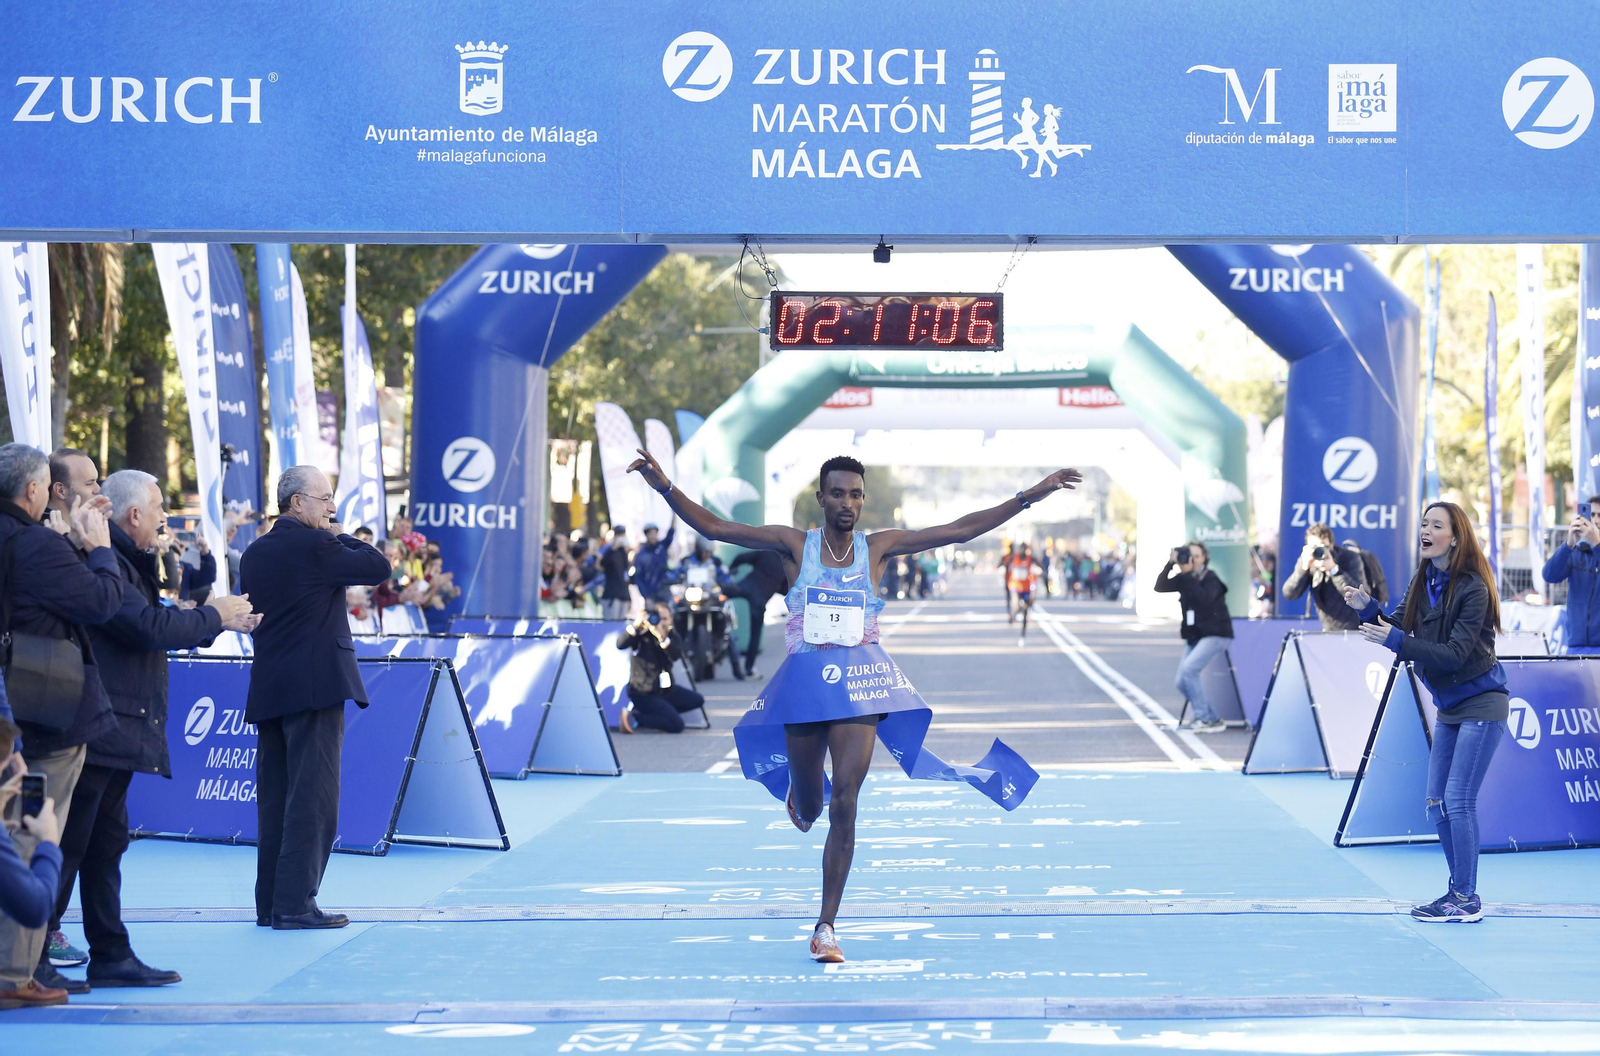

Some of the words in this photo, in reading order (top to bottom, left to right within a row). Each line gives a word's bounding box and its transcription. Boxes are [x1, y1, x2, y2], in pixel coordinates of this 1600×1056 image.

[752, 48, 947, 85] ZURICH
[1336, 70, 1361, 79] sabor
[13, 76, 263, 124] ZURICH
[752, 96, 946, 133] MARATÓN
[364, 125, 495, 144] Ayuntamiento
[501, 127, 525, 142] de
[530, 126, 598, 146] Málaga
[1185, 132, 1245, 147] diputación
[1248, 132, 1262, 144] de
[1265, 132, 1315, 147] málaga
[1327, 135, 1334, 144] El
[1335, 135, 1354, 144] sabor
[1355, 137, 1369, 146] que
[416, 148, 547, 165] #malagafunciona
[752, 142, 922, 179] MÁLAGA
[478, 270, 595, 295] ZURICH
[1228, 267, 1345, 293] ZURICH
[414, 502, 517, 530] ZURICH
[1290, 503, 1397, 530] ZURICH
[829, 595, 853, 603] ZURICH
[830, 613, 840, 622] 13
[846, 662, 891, 677] ZURICH
[847, 675, 893, 690] MARATÓN
[849, 689, 889, 702] MÁLAGA
[215, 709, 258, 735] ZUR
[1555, 748, 1600, 770] MAR
